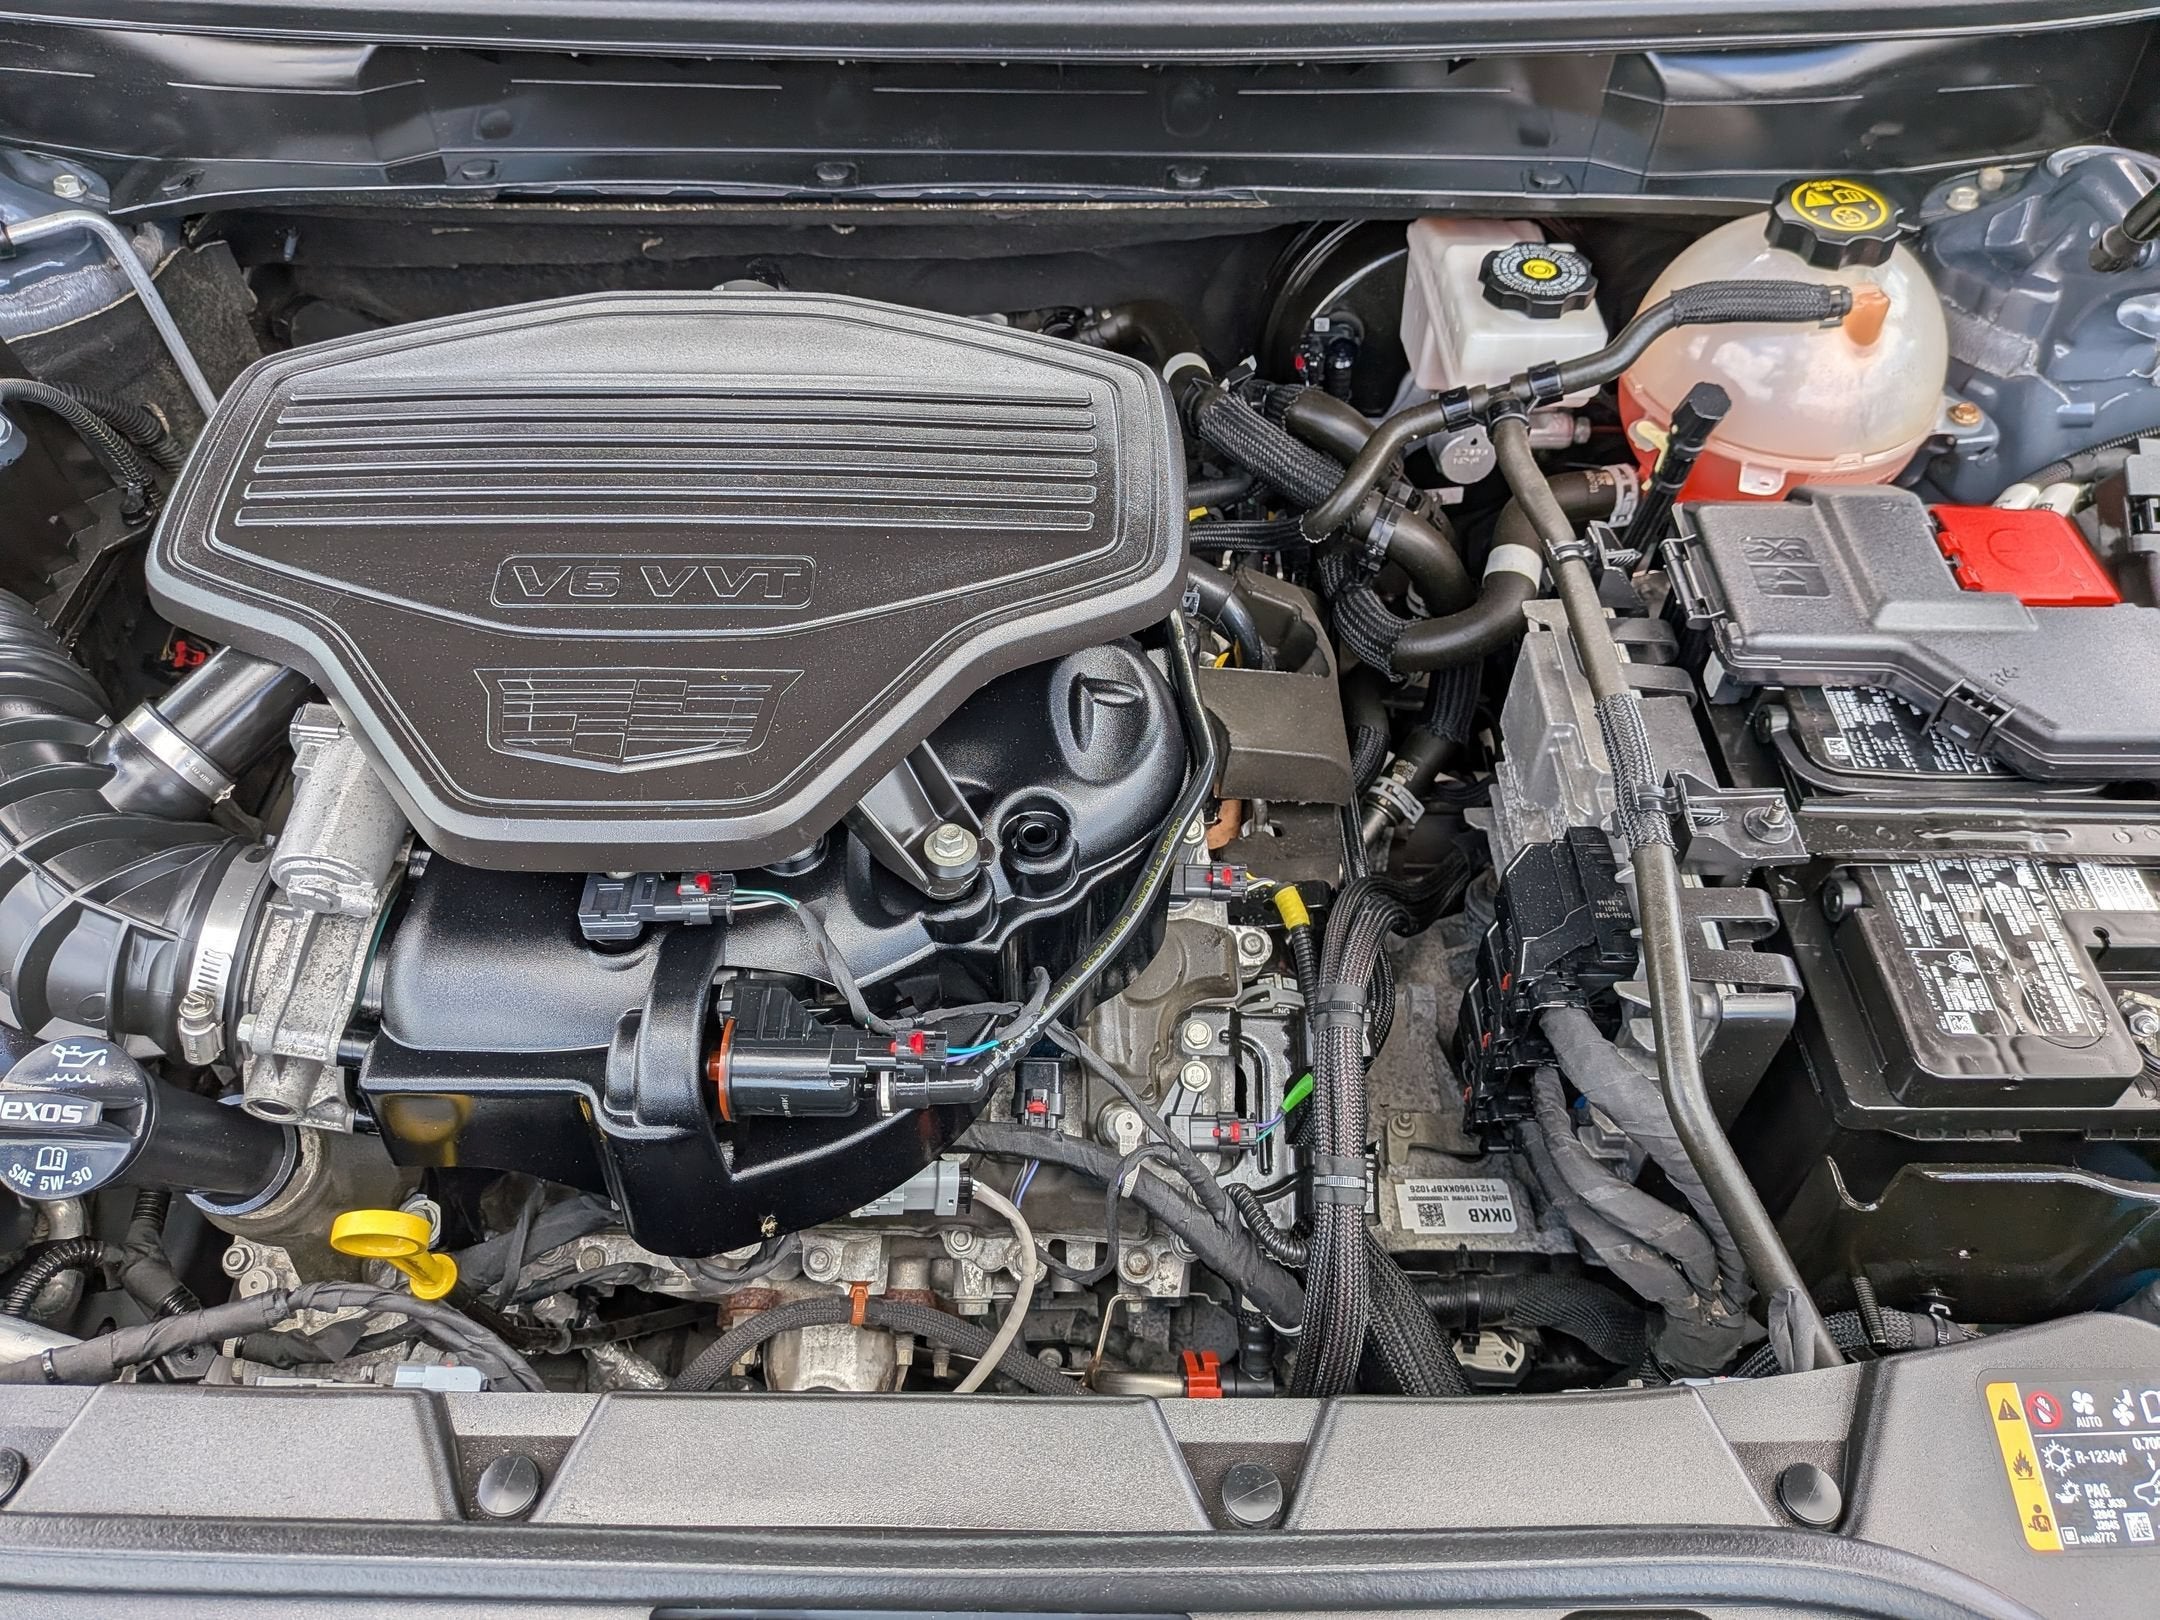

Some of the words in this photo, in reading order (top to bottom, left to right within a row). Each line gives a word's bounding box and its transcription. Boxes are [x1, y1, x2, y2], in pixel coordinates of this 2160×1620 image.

[513, 565, 623, 597] V6
[640, 565, 801, 598] VVT
[1160, 817, 1183, 855] COOPER
[1131, 858, 1163, 912] STANDARD
[2064, 870, 2091, 907] FoMoCo
[2035, 905, 2080, 973] PELIGRO/VENENO
[0, 1096, 85, 1124] exos
[8, 1163, 36, 1188] SAE
[39, 1166, 93, 1191] 5W-30
[2076, 1415, 2103, 1428] AUTO
[2074, 1448, 2128, 1466] R-1234yf
[2084, 1483, 2112, 1498] PAG
[2088, 1498, 2107, 1509] SAE
